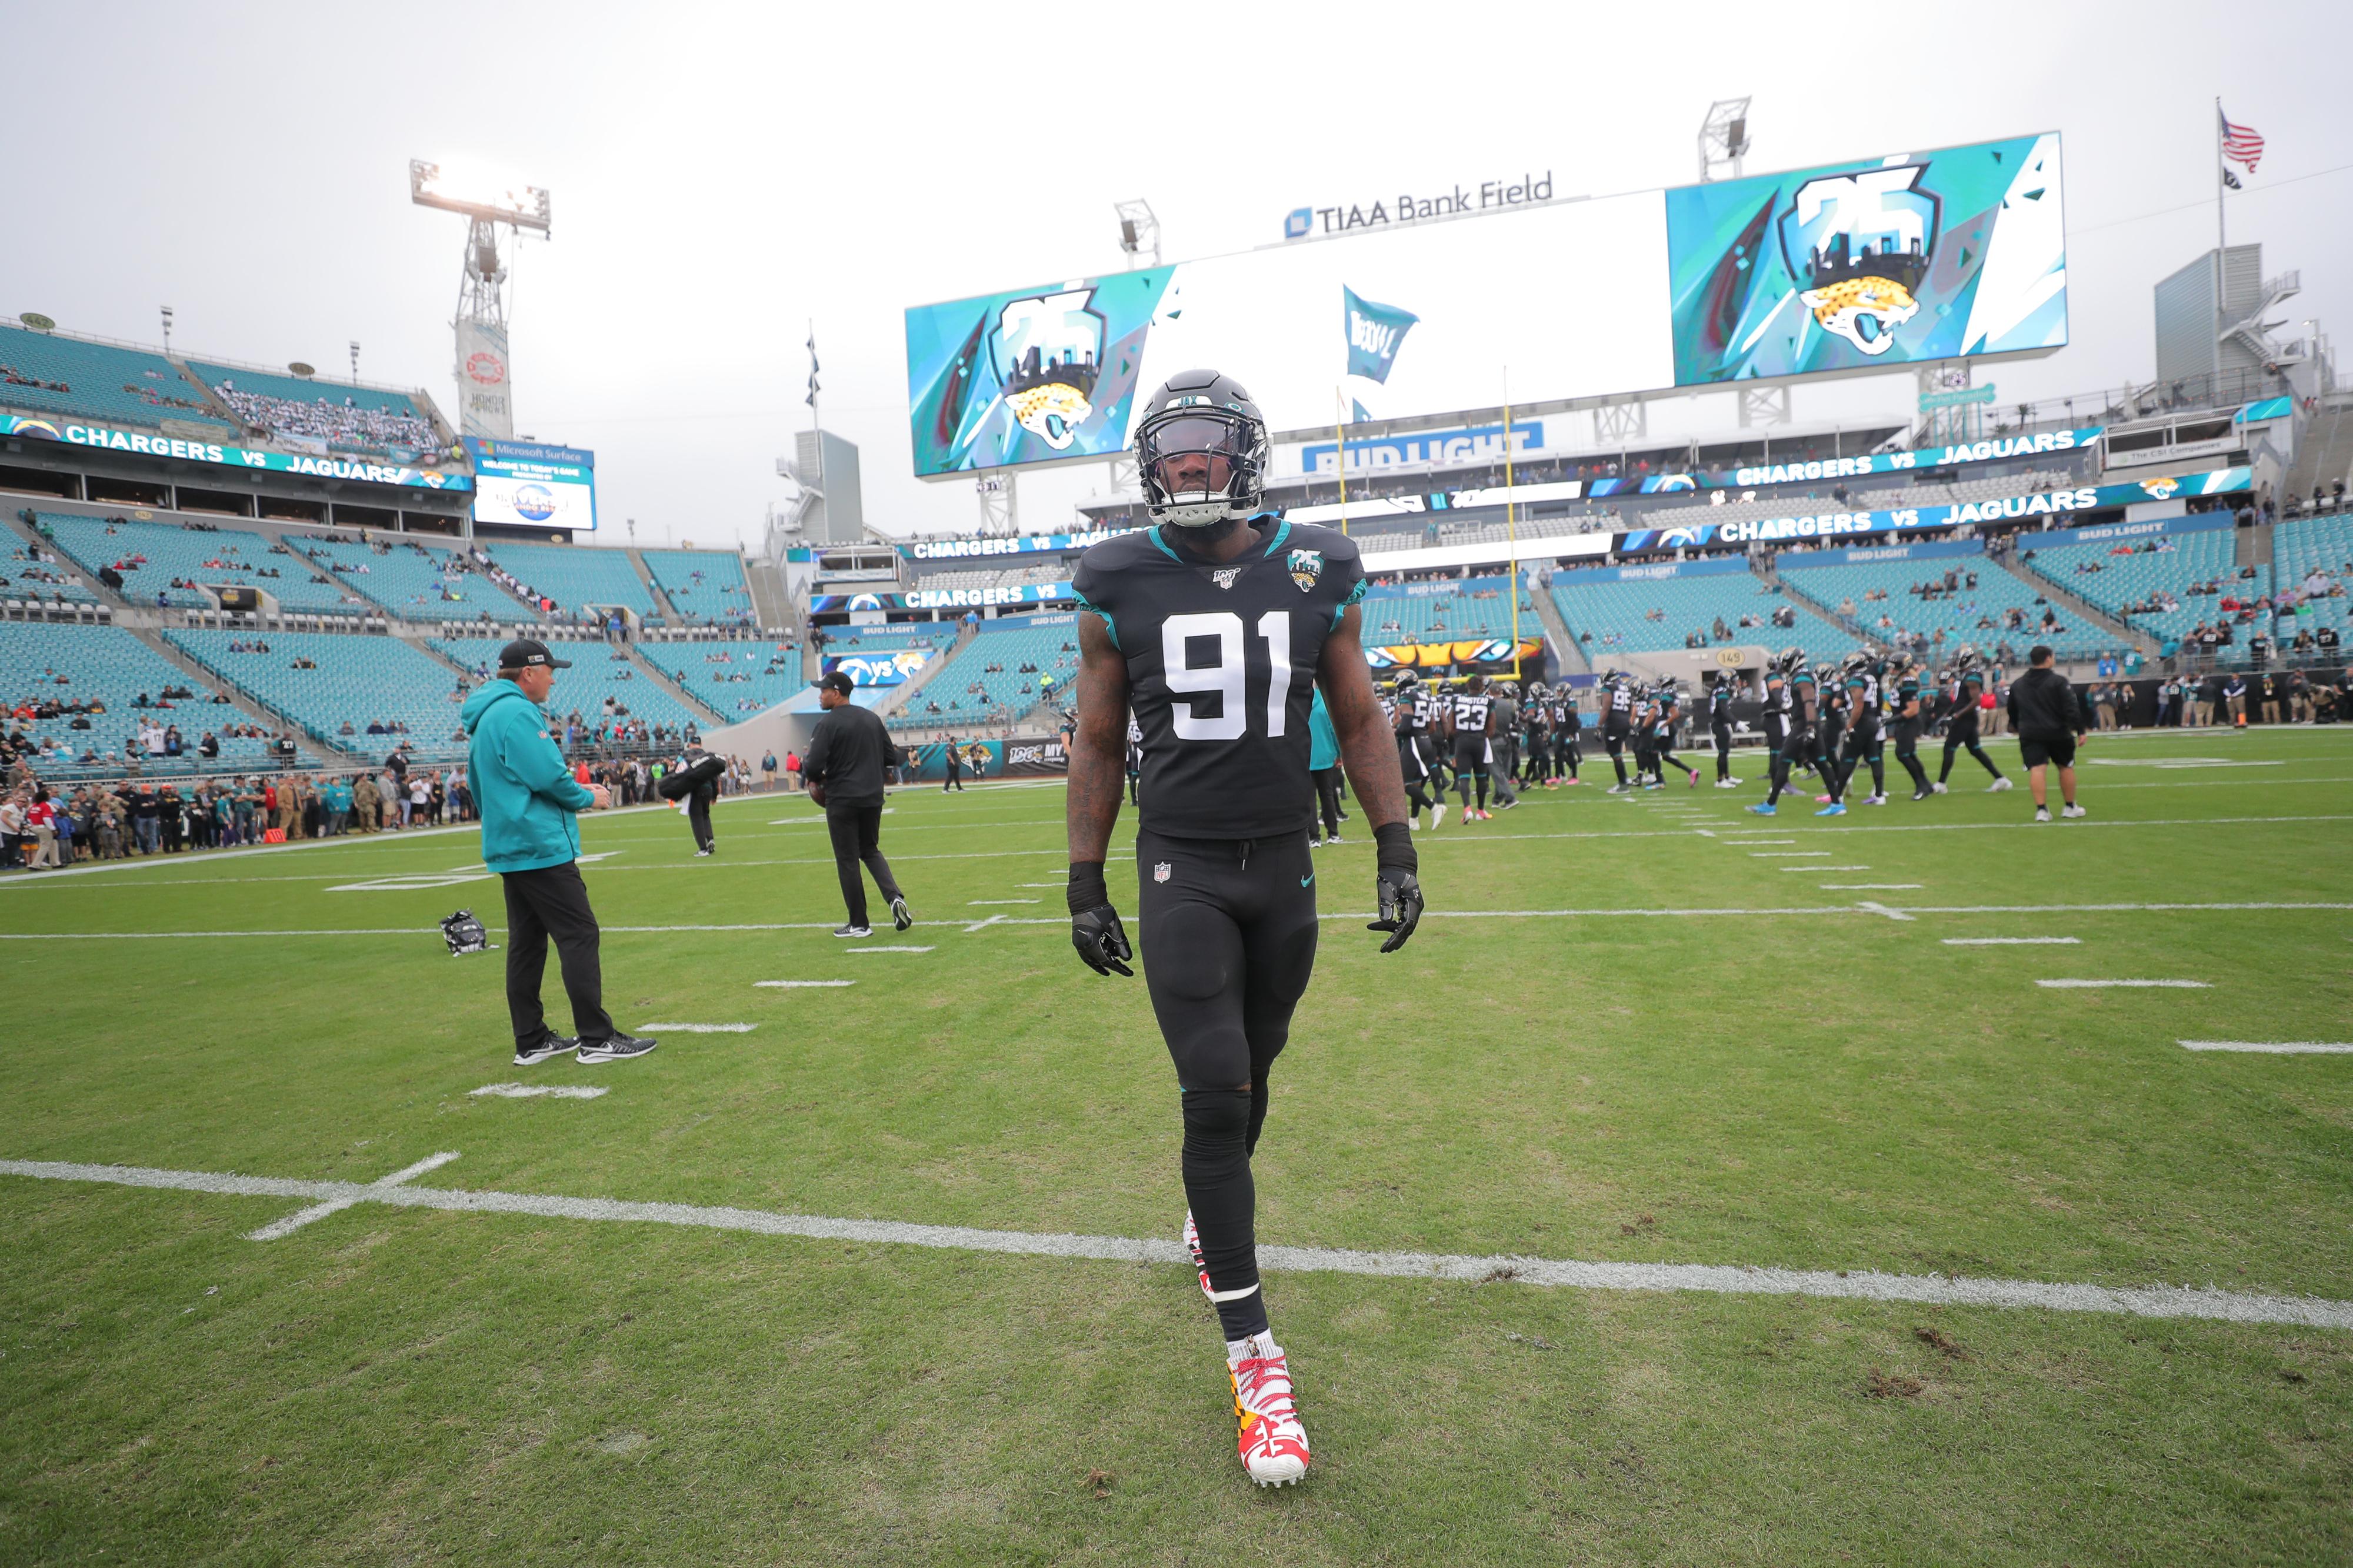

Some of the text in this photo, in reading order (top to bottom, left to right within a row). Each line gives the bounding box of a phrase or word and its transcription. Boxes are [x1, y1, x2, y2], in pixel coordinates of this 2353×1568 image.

[1317, 169, 1553, 232] TIAA Bank Field
[1178, 395, 1198, 406] JAX
[65, 425, 398, 483] CHARGERS VS JAGUARS
[496, 443, 582, 462] Microsoft Surface
[1315, 431, 1530, 470] BUD LIGHT
[1736, 431, 2075, 486] CHARGERS VS JAGUARS
[2131, 452, 2147, 461] The
[2170, 442, 2222, 455] Companies
[482, 459, 518, 471] WELCOME
[518, 463, 529, 472] TO
[1720, 488, 2097, 542] CHARGERS VS JAGUARS
[2078, 522, 2165, 541] BUD LIGHT
[914, 538, 1020, 559] CHARGERS
[1032, 536, 1051, 550] VS
[1849, 547, 1909, 561] BUD LIGHT
[1291, 549, 1322, 572] 25
[1621, 565, 1678, 578] BUD LIGHT
[905, 585, 1056, 608] CHARGERS VS
[1408, 583, 1460, 594] BUD LIGHT
[1031, 615, 1075, 626] BUD LIGHT
[1721, 652, 1741, 663] 149
[870, 660, 893, 678] VS
[1161, 610, 1293, 741] 91
[1455, 703, 1488, 731] 23
[1045, 744, 1063, 757] MY
[270, 830, 283, 840] 10
[1157, 871, 1168, 879] NFL
